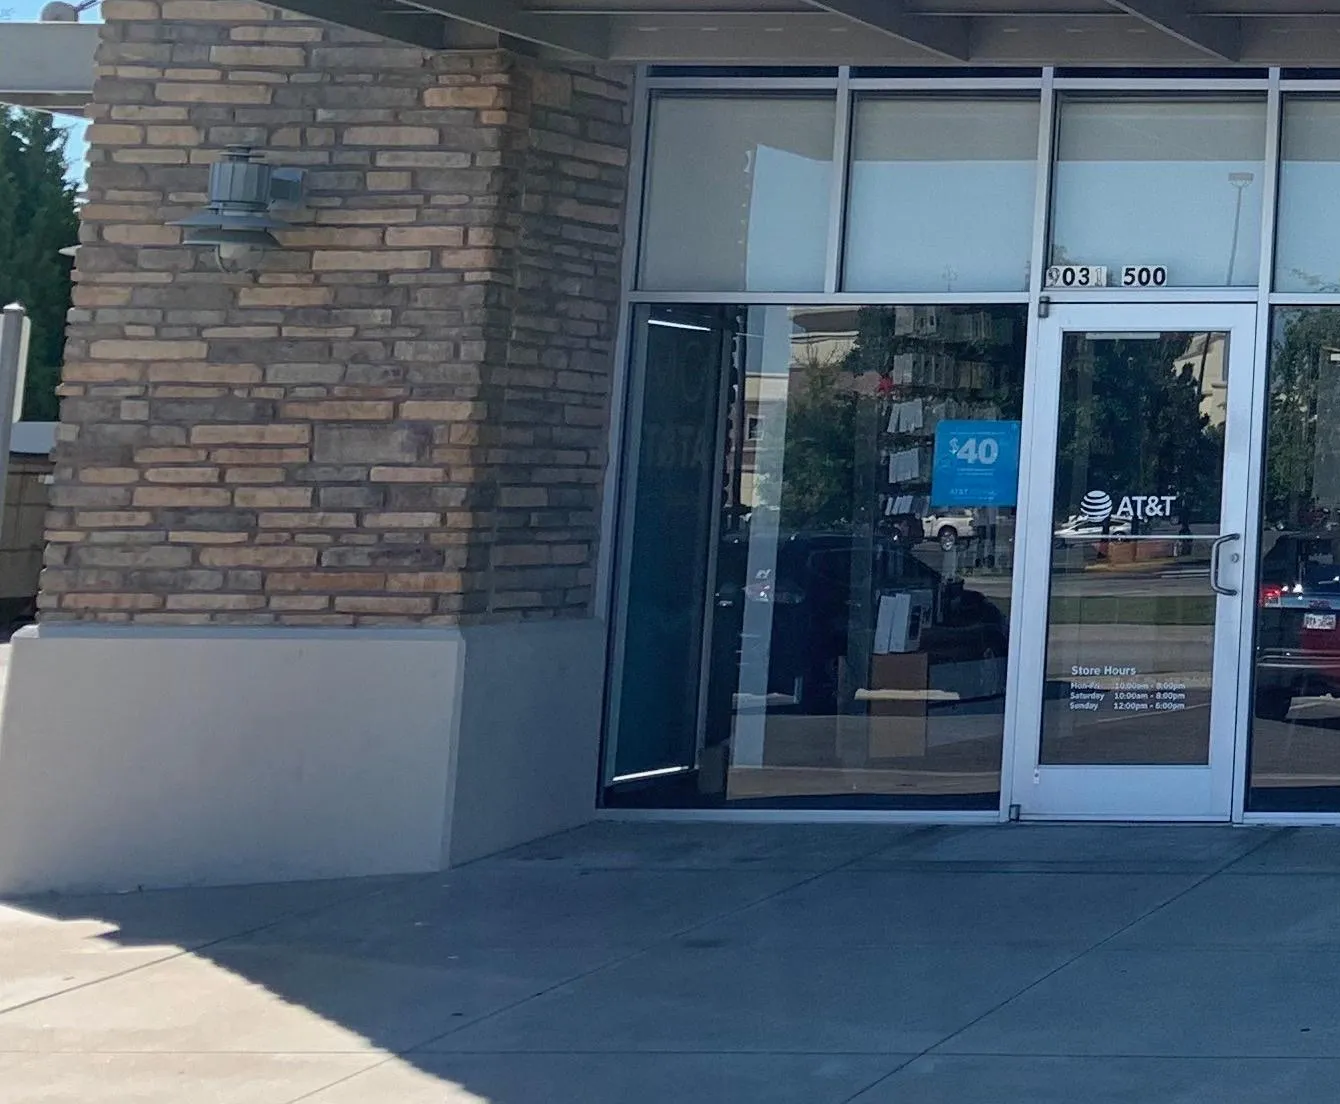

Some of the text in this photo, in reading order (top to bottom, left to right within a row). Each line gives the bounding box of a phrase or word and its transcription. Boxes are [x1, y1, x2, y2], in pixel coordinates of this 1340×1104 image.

[1123, 267, 1167, 286] 500
[948, 437, 999, 465] $40
[1117, 496, 1177, 518] AT&T
[1071, 665, 1137, 676] Store Hours
[1070, 692, 1105, 702] Saturday
[1114, 692, 1149, 700] 10:00am
[1069, 702, 1099, 711] Sunday
[1113, 702, 1148, 711] 12:00pm
